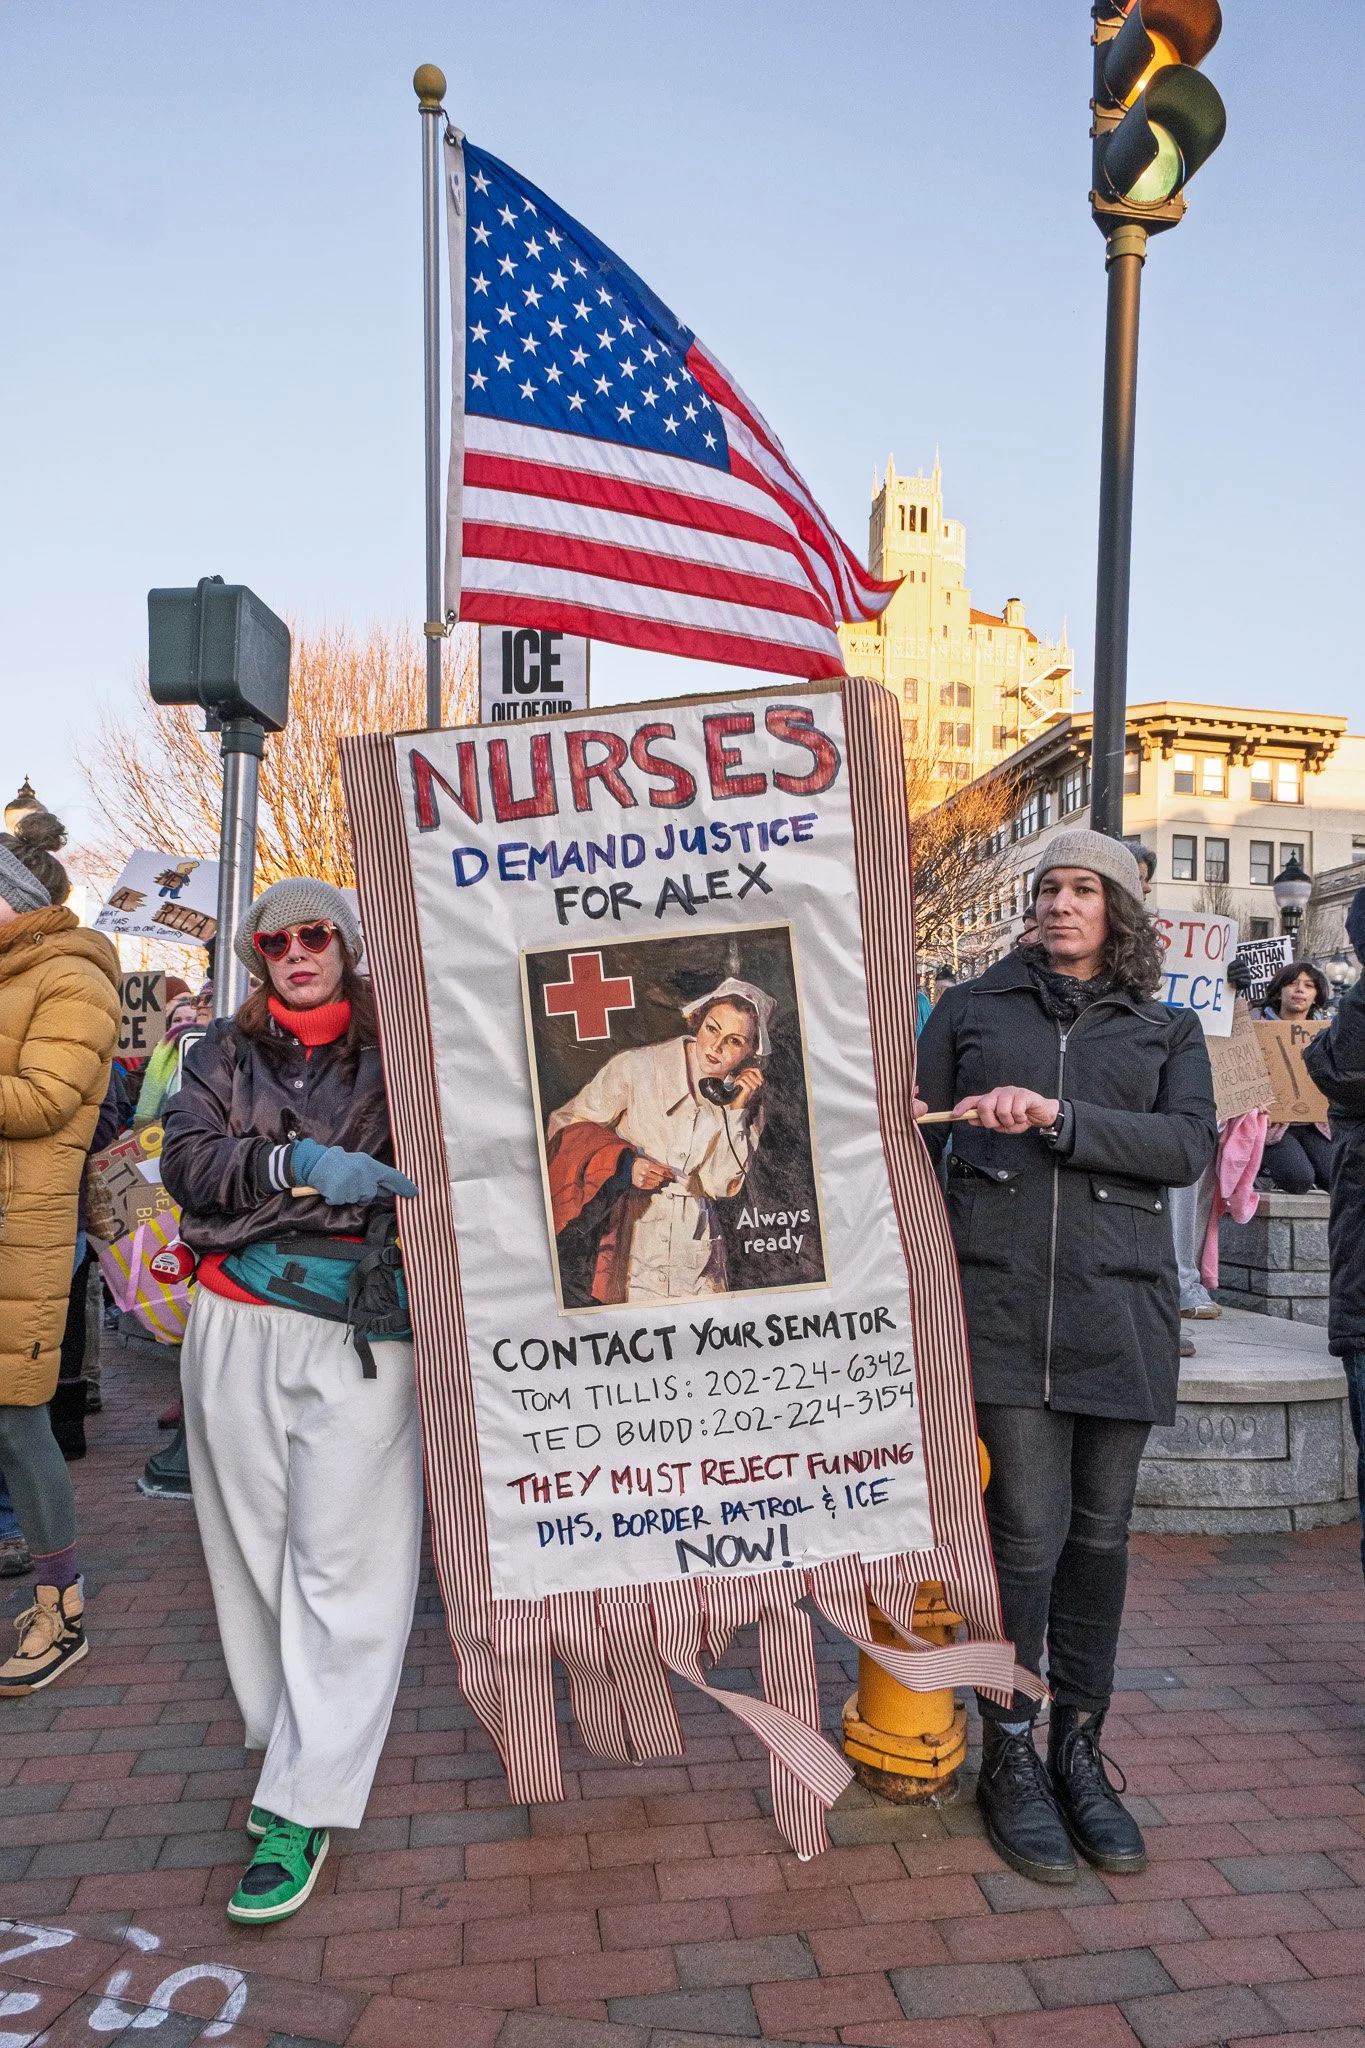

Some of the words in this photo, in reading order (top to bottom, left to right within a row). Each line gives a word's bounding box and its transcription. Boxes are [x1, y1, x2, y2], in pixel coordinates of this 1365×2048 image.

[502, 629, 563, 694] ICE
[491, 702, 520, 722] OUT
[408, 705, 842, 832] NURSES
[452, 832, 646, 888] DEMAND
[654, 812, 818, 860] JUSTICE
[554, 880, 642, 925] FOR
[655, 861, 773, 919] ALEX
[1152, 919, 1231, 962] STOP
[117, 975, 161, 1012] CK
[1160, 973, 1224, 1011] ICE
[736, 1207, 811, 1230] Always
[744, 1228, 804, 1254] ready
[493, 1325, 676, 1373] CONTACT
[690, 1317, 764, 1356] YOUR
[766, 1305, 896, 1348] SENATOR
[512, 1386, 571, 1414] TOM
[586, 1376, 693, 1411] TILLIS:
[705, 1351, 912, 1398] 202-224-6342
[524, 1423, 600, 1454] TED
[712, 1381, 914, 1437] 202-224-3154
[1174, 1416, 1257, 1444] 2009
[508, 1465, 600, 1504] THEY
[610, 1461, 692, 1497] MUST
[700, 1453, 799, 1487] REJECT
[807, 1442, 914, 1479] FUNDING
[537, 1516, 602, 1548] DHS,
[612, 1504, 711, 1538] BORDER
[721, 1494, 814, 1525] PATROL
[822, 1484, 836, 1519] &
[845, 1477, 896, 1510] ICE
[675, 1523, 794, 1574] NOW!
